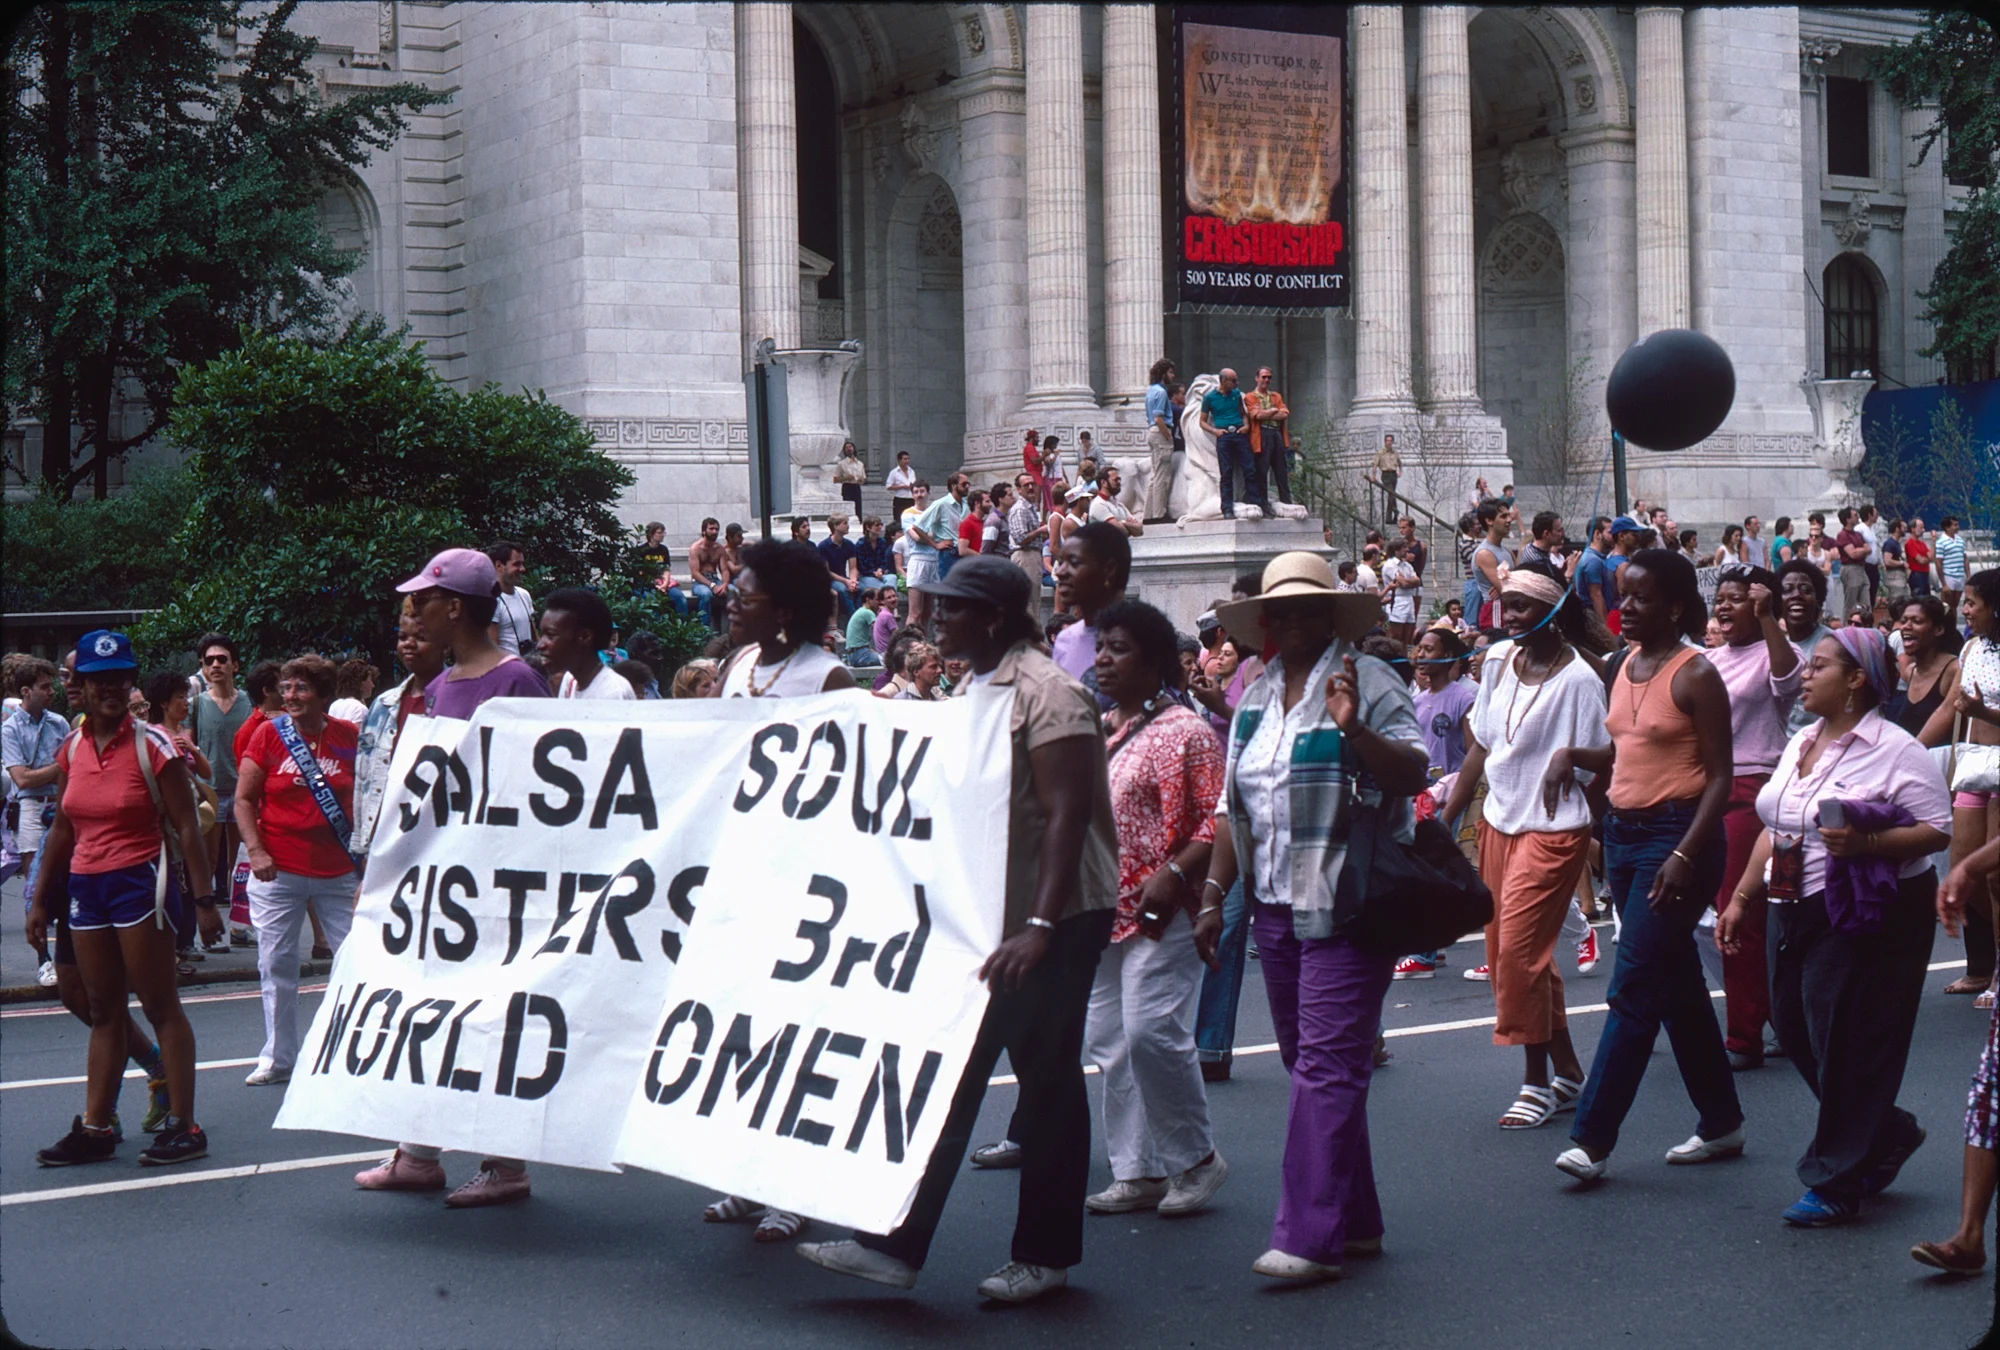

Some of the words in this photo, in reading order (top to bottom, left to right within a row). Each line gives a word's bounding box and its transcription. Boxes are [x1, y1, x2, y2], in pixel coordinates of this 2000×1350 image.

[1235, 73, 1249, 85] the
[1251, 76, 1278, 90] People
[1184, 215, 1343, 266] CENSORSHIP
[1186, 270, 1206, 285] 500
[1208, 272, 1251, 287] YEARS
[1254, 273, 1273, 289] OF
[1276, 274, 1344, 290] CONFLICT
[400, 727, 658, 833] SALSA
[734, 720, 932, 841] SOUL
[382, 858, 709, 965] SISTERS
[771, 874, 932, 993] 3rd
[312, 984, 568, 1101] WORLD
[644, 1000, 942, 1164] OMEN
